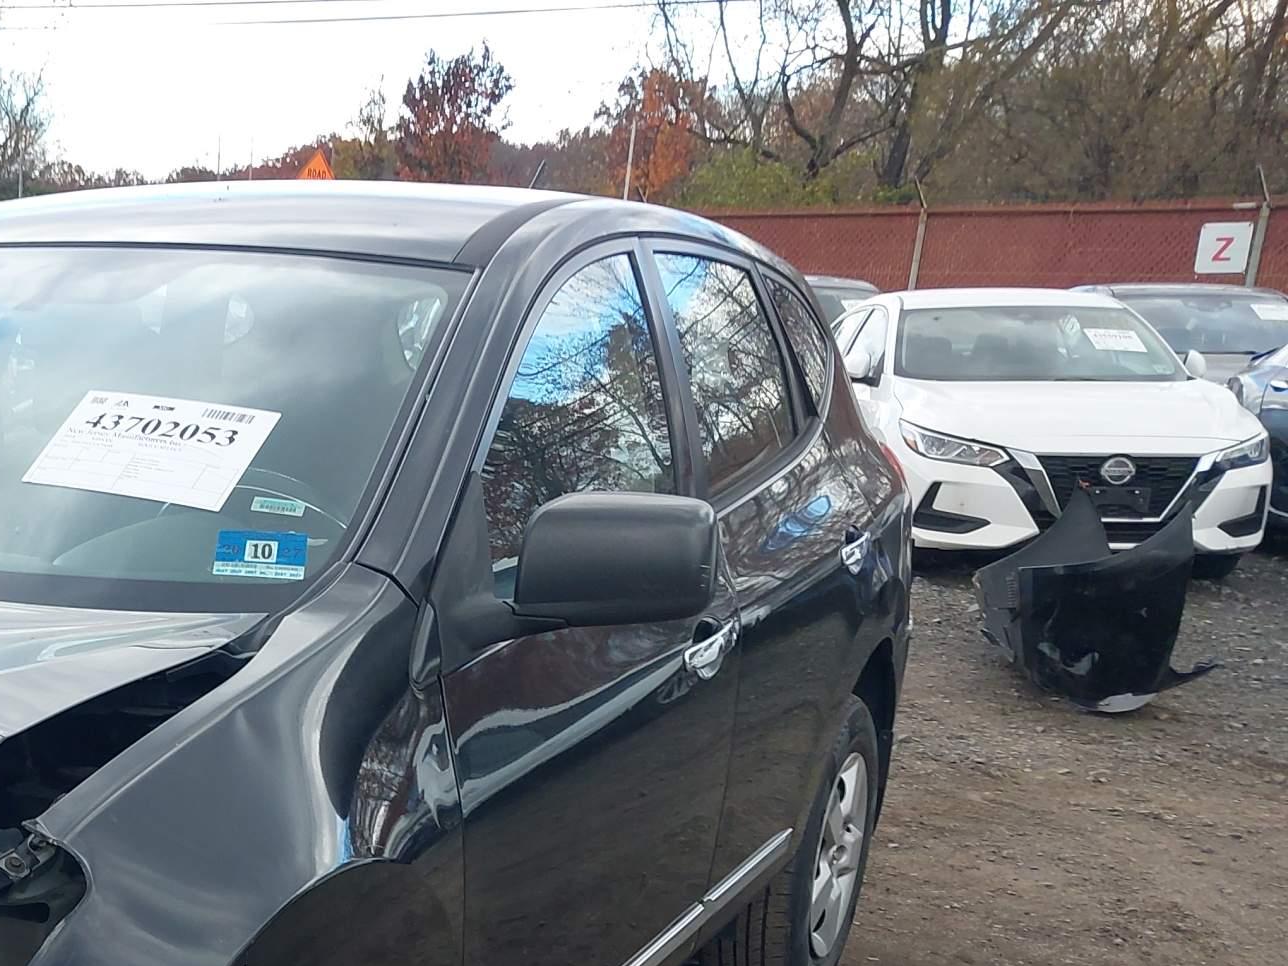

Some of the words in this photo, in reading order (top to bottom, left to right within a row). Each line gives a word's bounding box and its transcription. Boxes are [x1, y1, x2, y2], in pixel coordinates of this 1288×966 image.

[1211, 237, 1235, 261] Z
[85, 412, 239, 447] 43702053
[250, 543, 273, 560] 10
